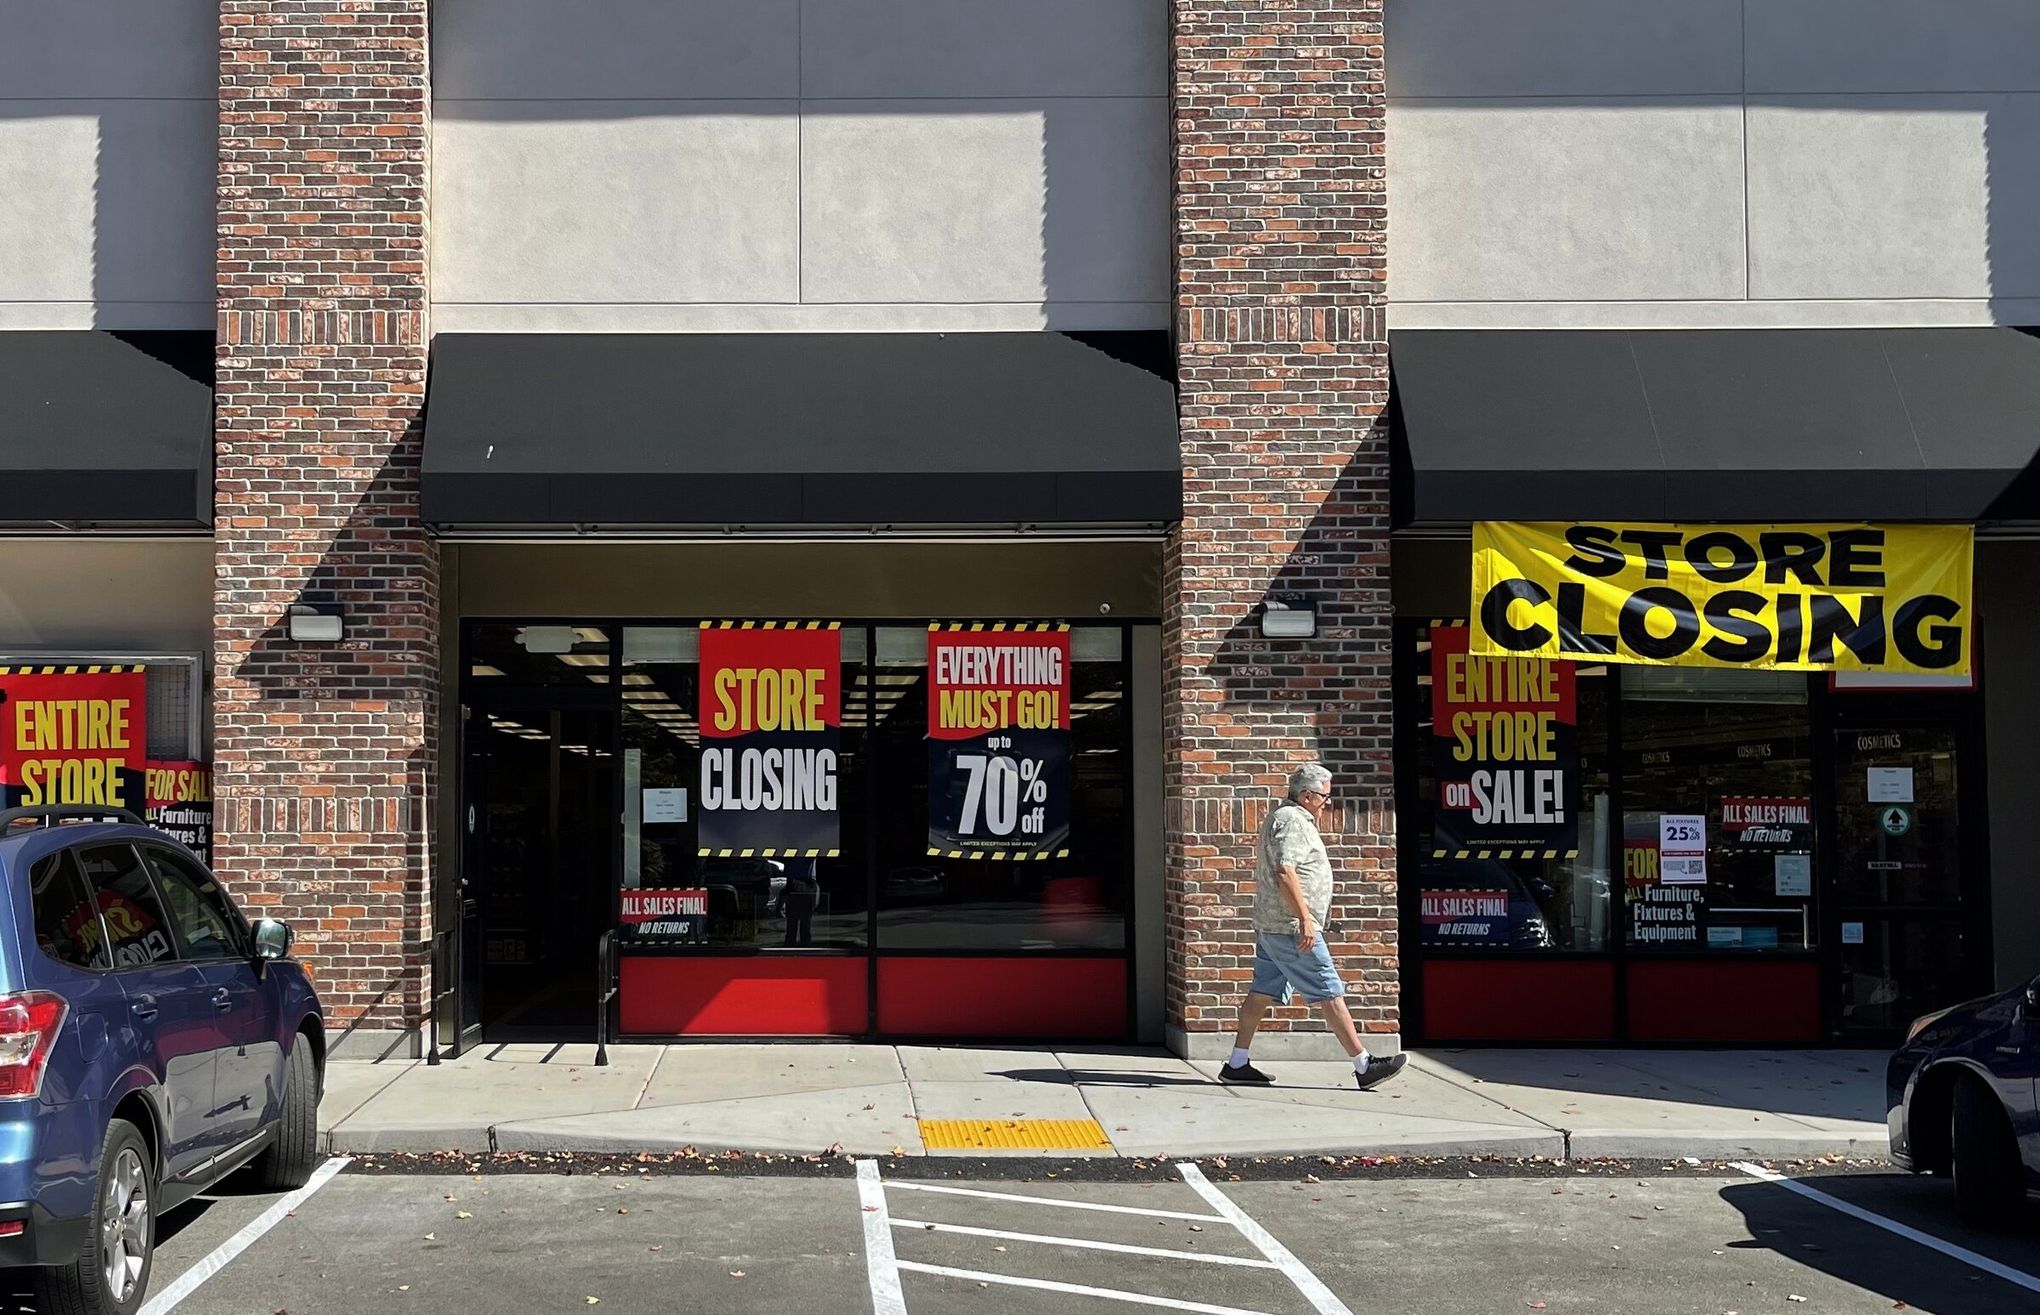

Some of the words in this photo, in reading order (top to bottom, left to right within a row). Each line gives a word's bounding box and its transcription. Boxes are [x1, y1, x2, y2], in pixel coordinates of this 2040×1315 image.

[1564, 525, 1886, 587] STORE
[1480, 577, 1962, 668] CLOSING
[936, 646, 1062, 686] EVERYTHING
[1446, 653, 1560, 702] ENTIRE
[714, 668, 825, 732] STORE
[940, 690, 1012, 729] MUST
[1017, 690, 1059, 729] GO!
[16, 700, 130, 750] ENTIRE
[1452, 711, 1556, 762] STORE
[988, 736, 1000, 751] up
[1001, 736, 1011, 748] to
[1857, 734, 1901, 750] COSMETICS
[21, 758, 125, 808] STORE
[145, 768, 176, 800] FOR
[700, 748, 837, 811] CLOSING
[956, 755, 1047, 836] 70%
[1446, 783, 1470, 807] on
[1471, 770, 1564, 825] SALE!
[1022, 807, 1045, 834] off
[1723, 805, 1742, 823] ALL
[1744, 805, 1777, 823] SALES
[1779, 806, 1810, 824] FINAL
[198, 826, 206, 844] &
[1740, 830, 1752, 842] NO
[1753, 829, 1792, 842] RETURNS
[1624, 848, 1658, 879] FOR
[622, 897, 641, 915] ALL
[644, 897, 675, 915] SALES
[677, 897, 706, 915] FINAL
[1421, 898, 1440, 916] ALL
[1442, 898, 1475, 916] SALES
[1476, 899, 1508, 917] FINAL
[1645, 884, 1704, 903] Furniture,
[1634, 903, 1683, 920] Fixtures
[1686, 903, 1695, 921] &
[638, 922, 651, 934] NO
[651, 922, 690, 934] RETURNS
[1438, 923, 1451, 935] NO
[1451, 923, 1491, 935] RETURNS
[1634, 922, 1697, 943] Equipment
